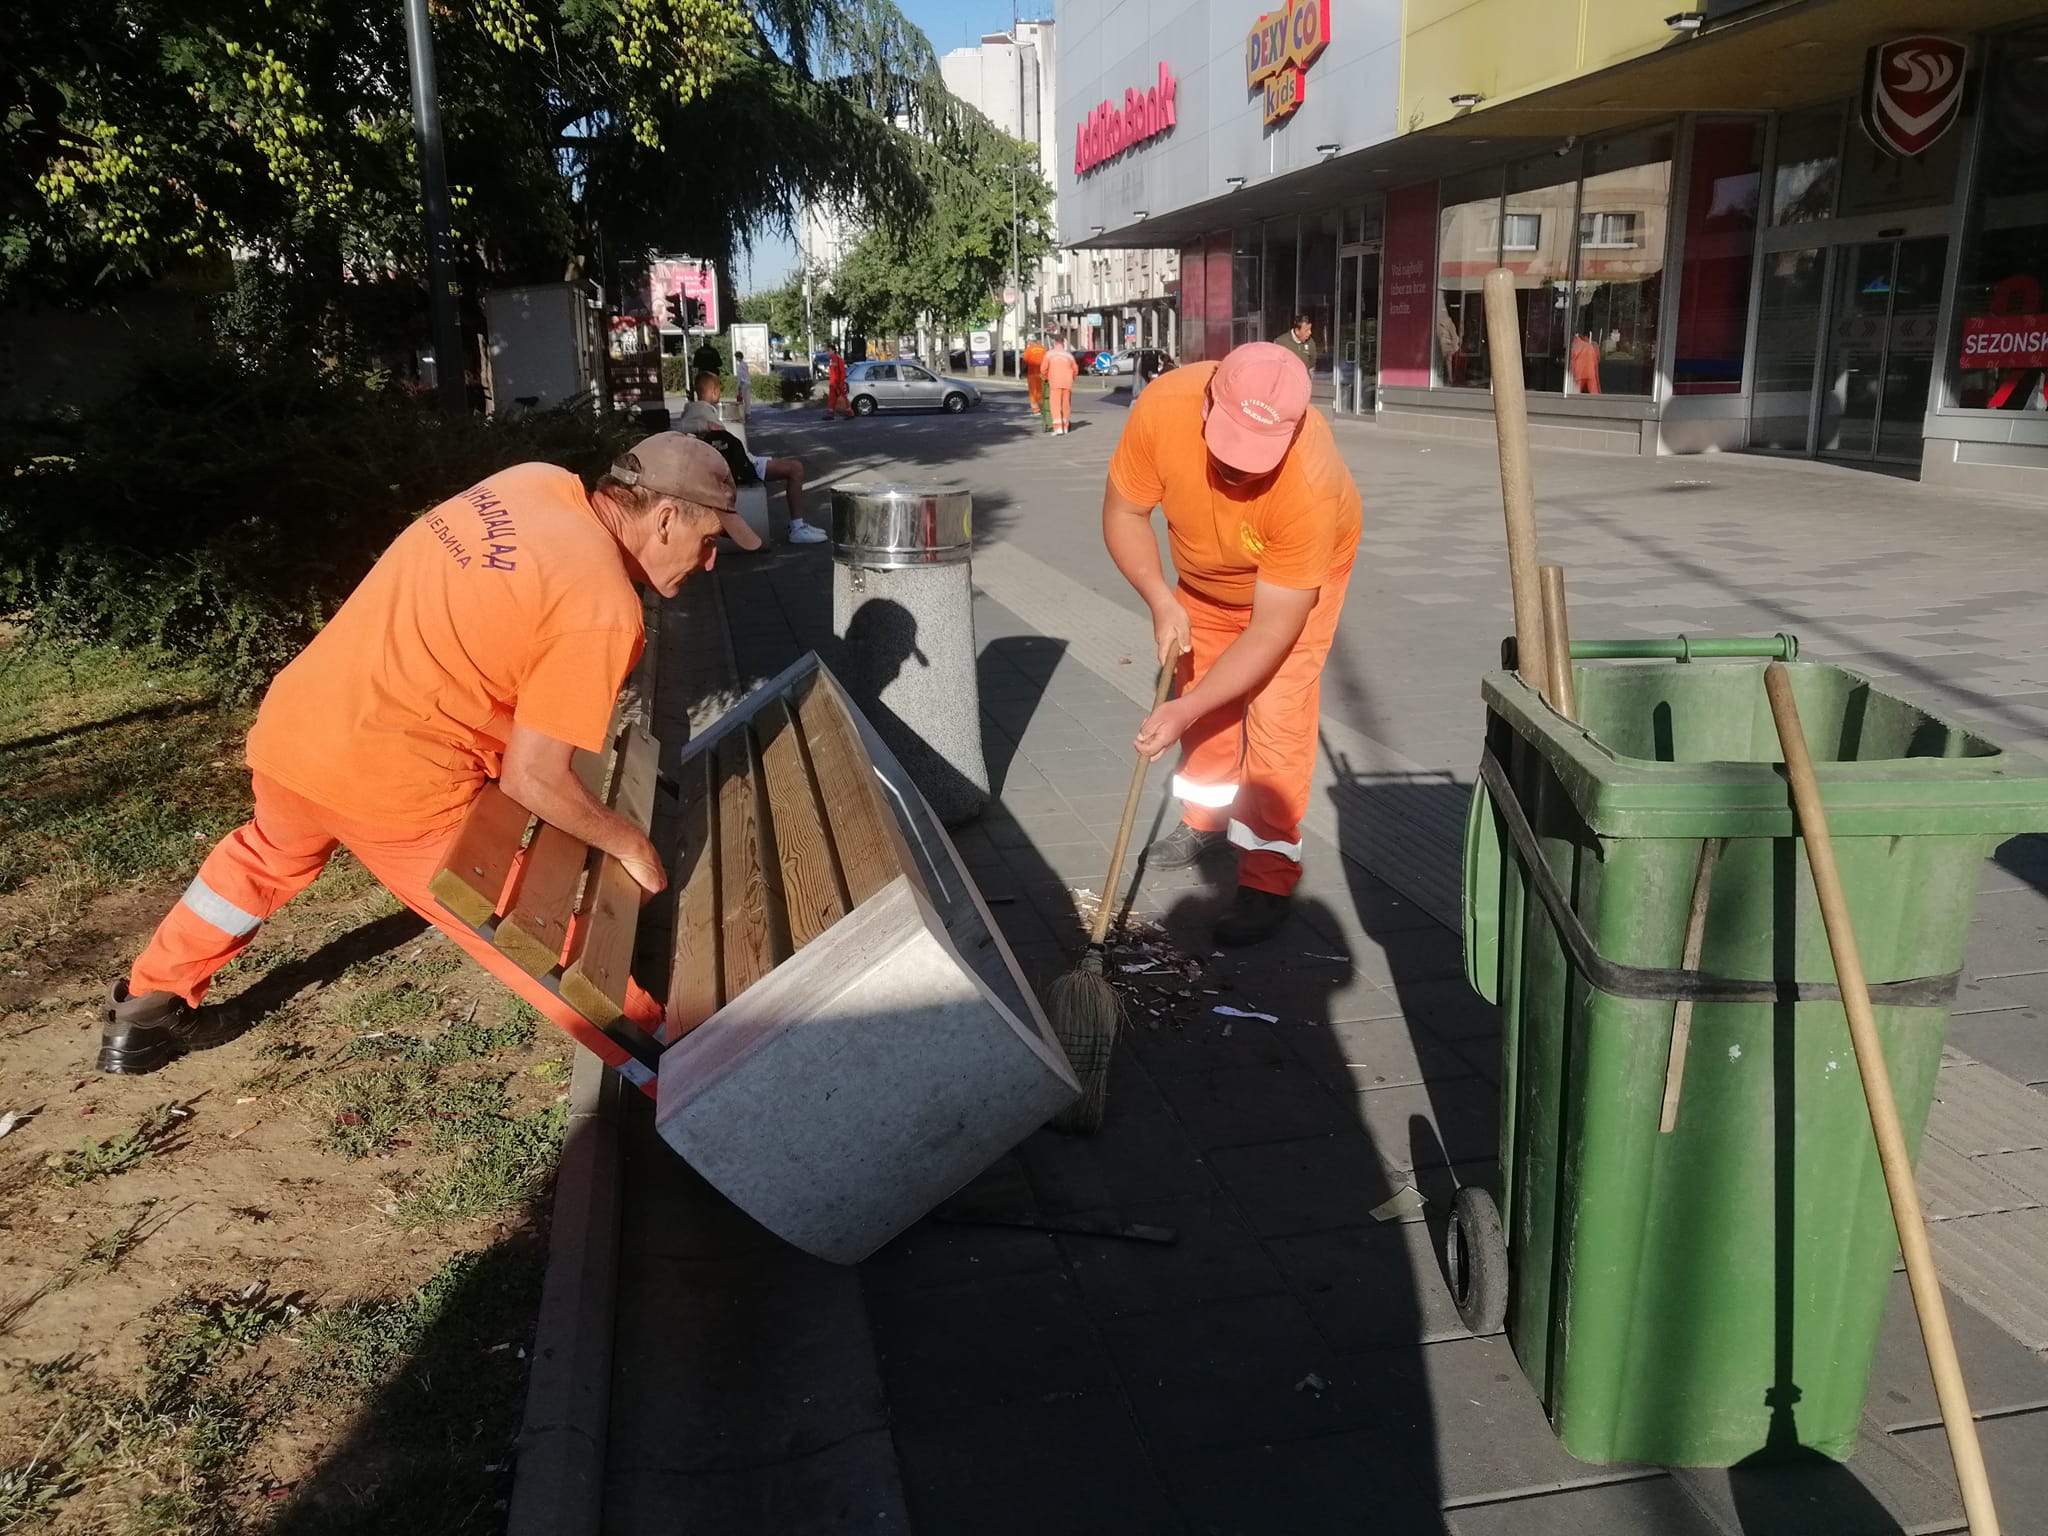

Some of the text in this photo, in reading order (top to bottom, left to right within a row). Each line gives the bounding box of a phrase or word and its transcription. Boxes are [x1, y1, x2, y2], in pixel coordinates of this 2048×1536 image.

[1250, 1, 1318, 73] DEXY CO
[1074, 61, 1177, 175] Addiko Bank
[1266, 74, 1295, 118] kids
[480, 543, 517, 571] АД
